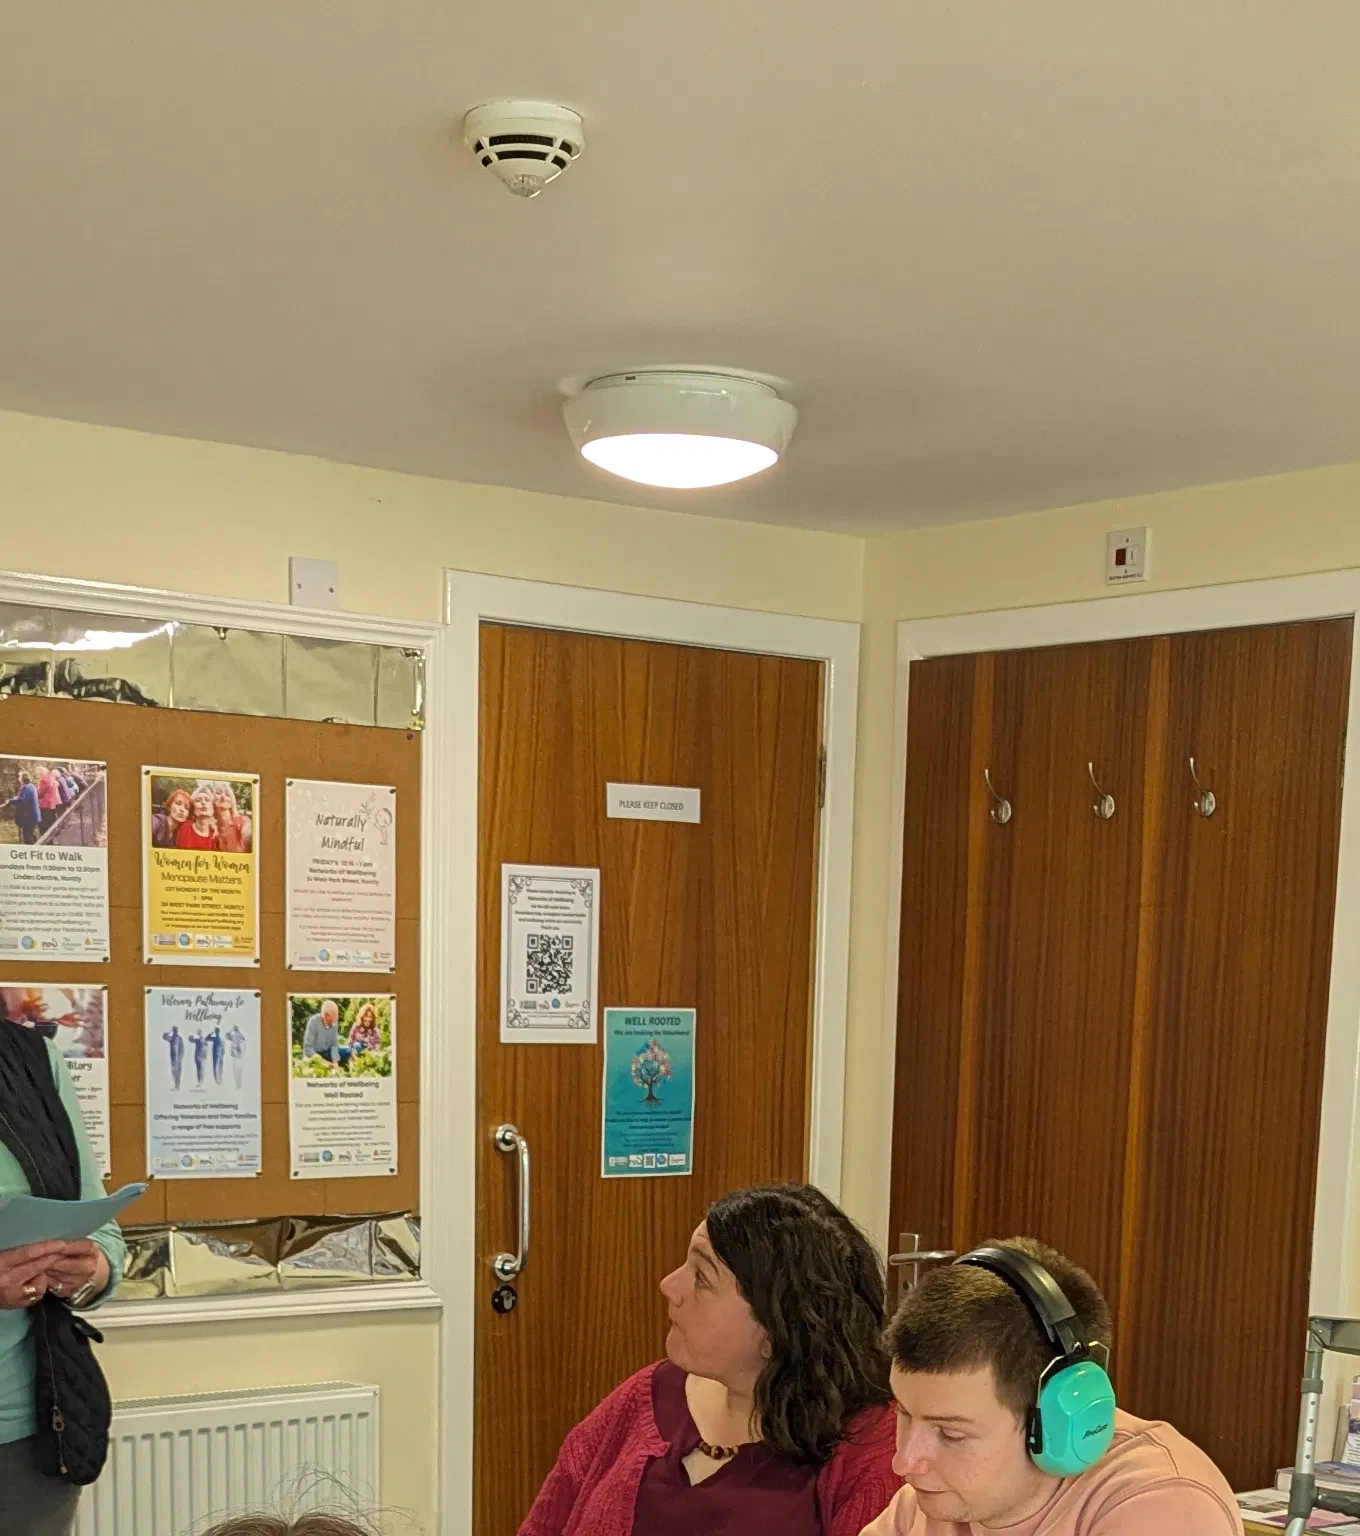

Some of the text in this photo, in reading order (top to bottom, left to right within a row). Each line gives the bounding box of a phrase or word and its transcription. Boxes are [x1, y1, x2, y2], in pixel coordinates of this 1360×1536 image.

[619, 800, 641, 808] PLEASE
[316, 814, 368, 832] Naturally
[321, 836, 365, 852] Mindful
[10, 850, 82, 861] Get Fit to Walk
[155, 852, 250, 874] Women for Women
[162, 872, 242, 884] Menopause Matters
[185, 1010, 222, 1025] Wellbeing
[625, 1017, 681, 1025] WELL ROOTED
